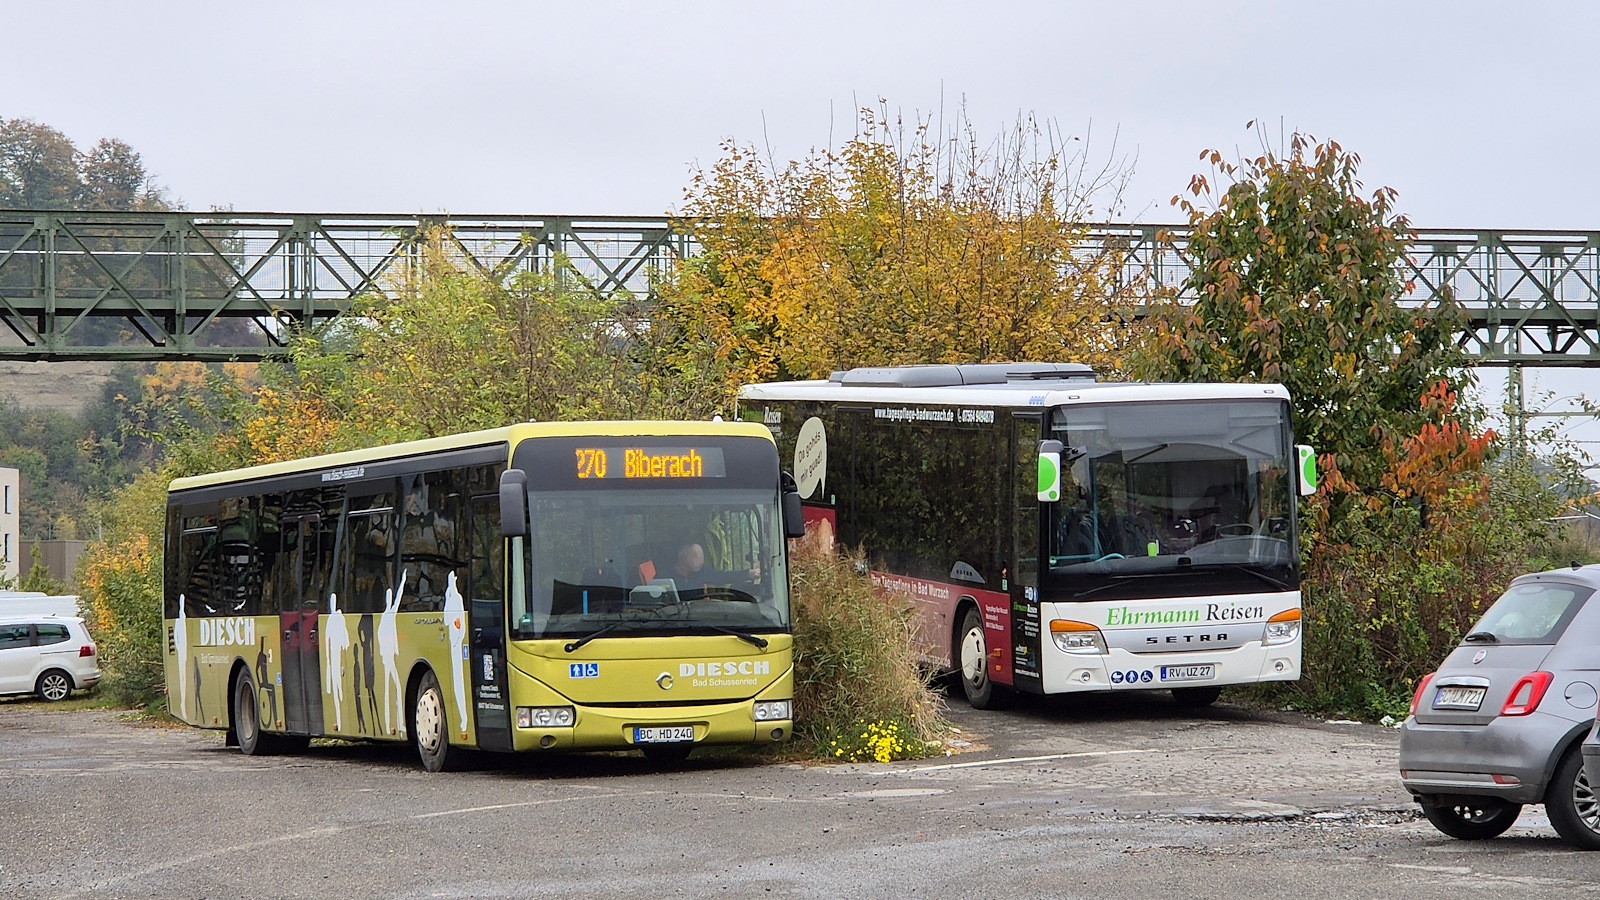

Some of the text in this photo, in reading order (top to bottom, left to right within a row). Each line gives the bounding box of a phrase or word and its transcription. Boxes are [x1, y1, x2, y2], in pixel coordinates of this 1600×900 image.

[575, 448, 703, 479] 270 Biberach
[917, 581, 928, 596] Bad
[1105, 602, 1264, 626] Ehrmann Reisen
[200, 617, 255, 646] DIESCH
[1146, 633, 1228, 645] SETRA
[680, 661, 770, 677] DIESCH
[1169, 666, 1211, 678] RV UZ 27
[692, 678, 758, 687] Bad Schussenried
[640, 728, 692, 740] BC HD 240
